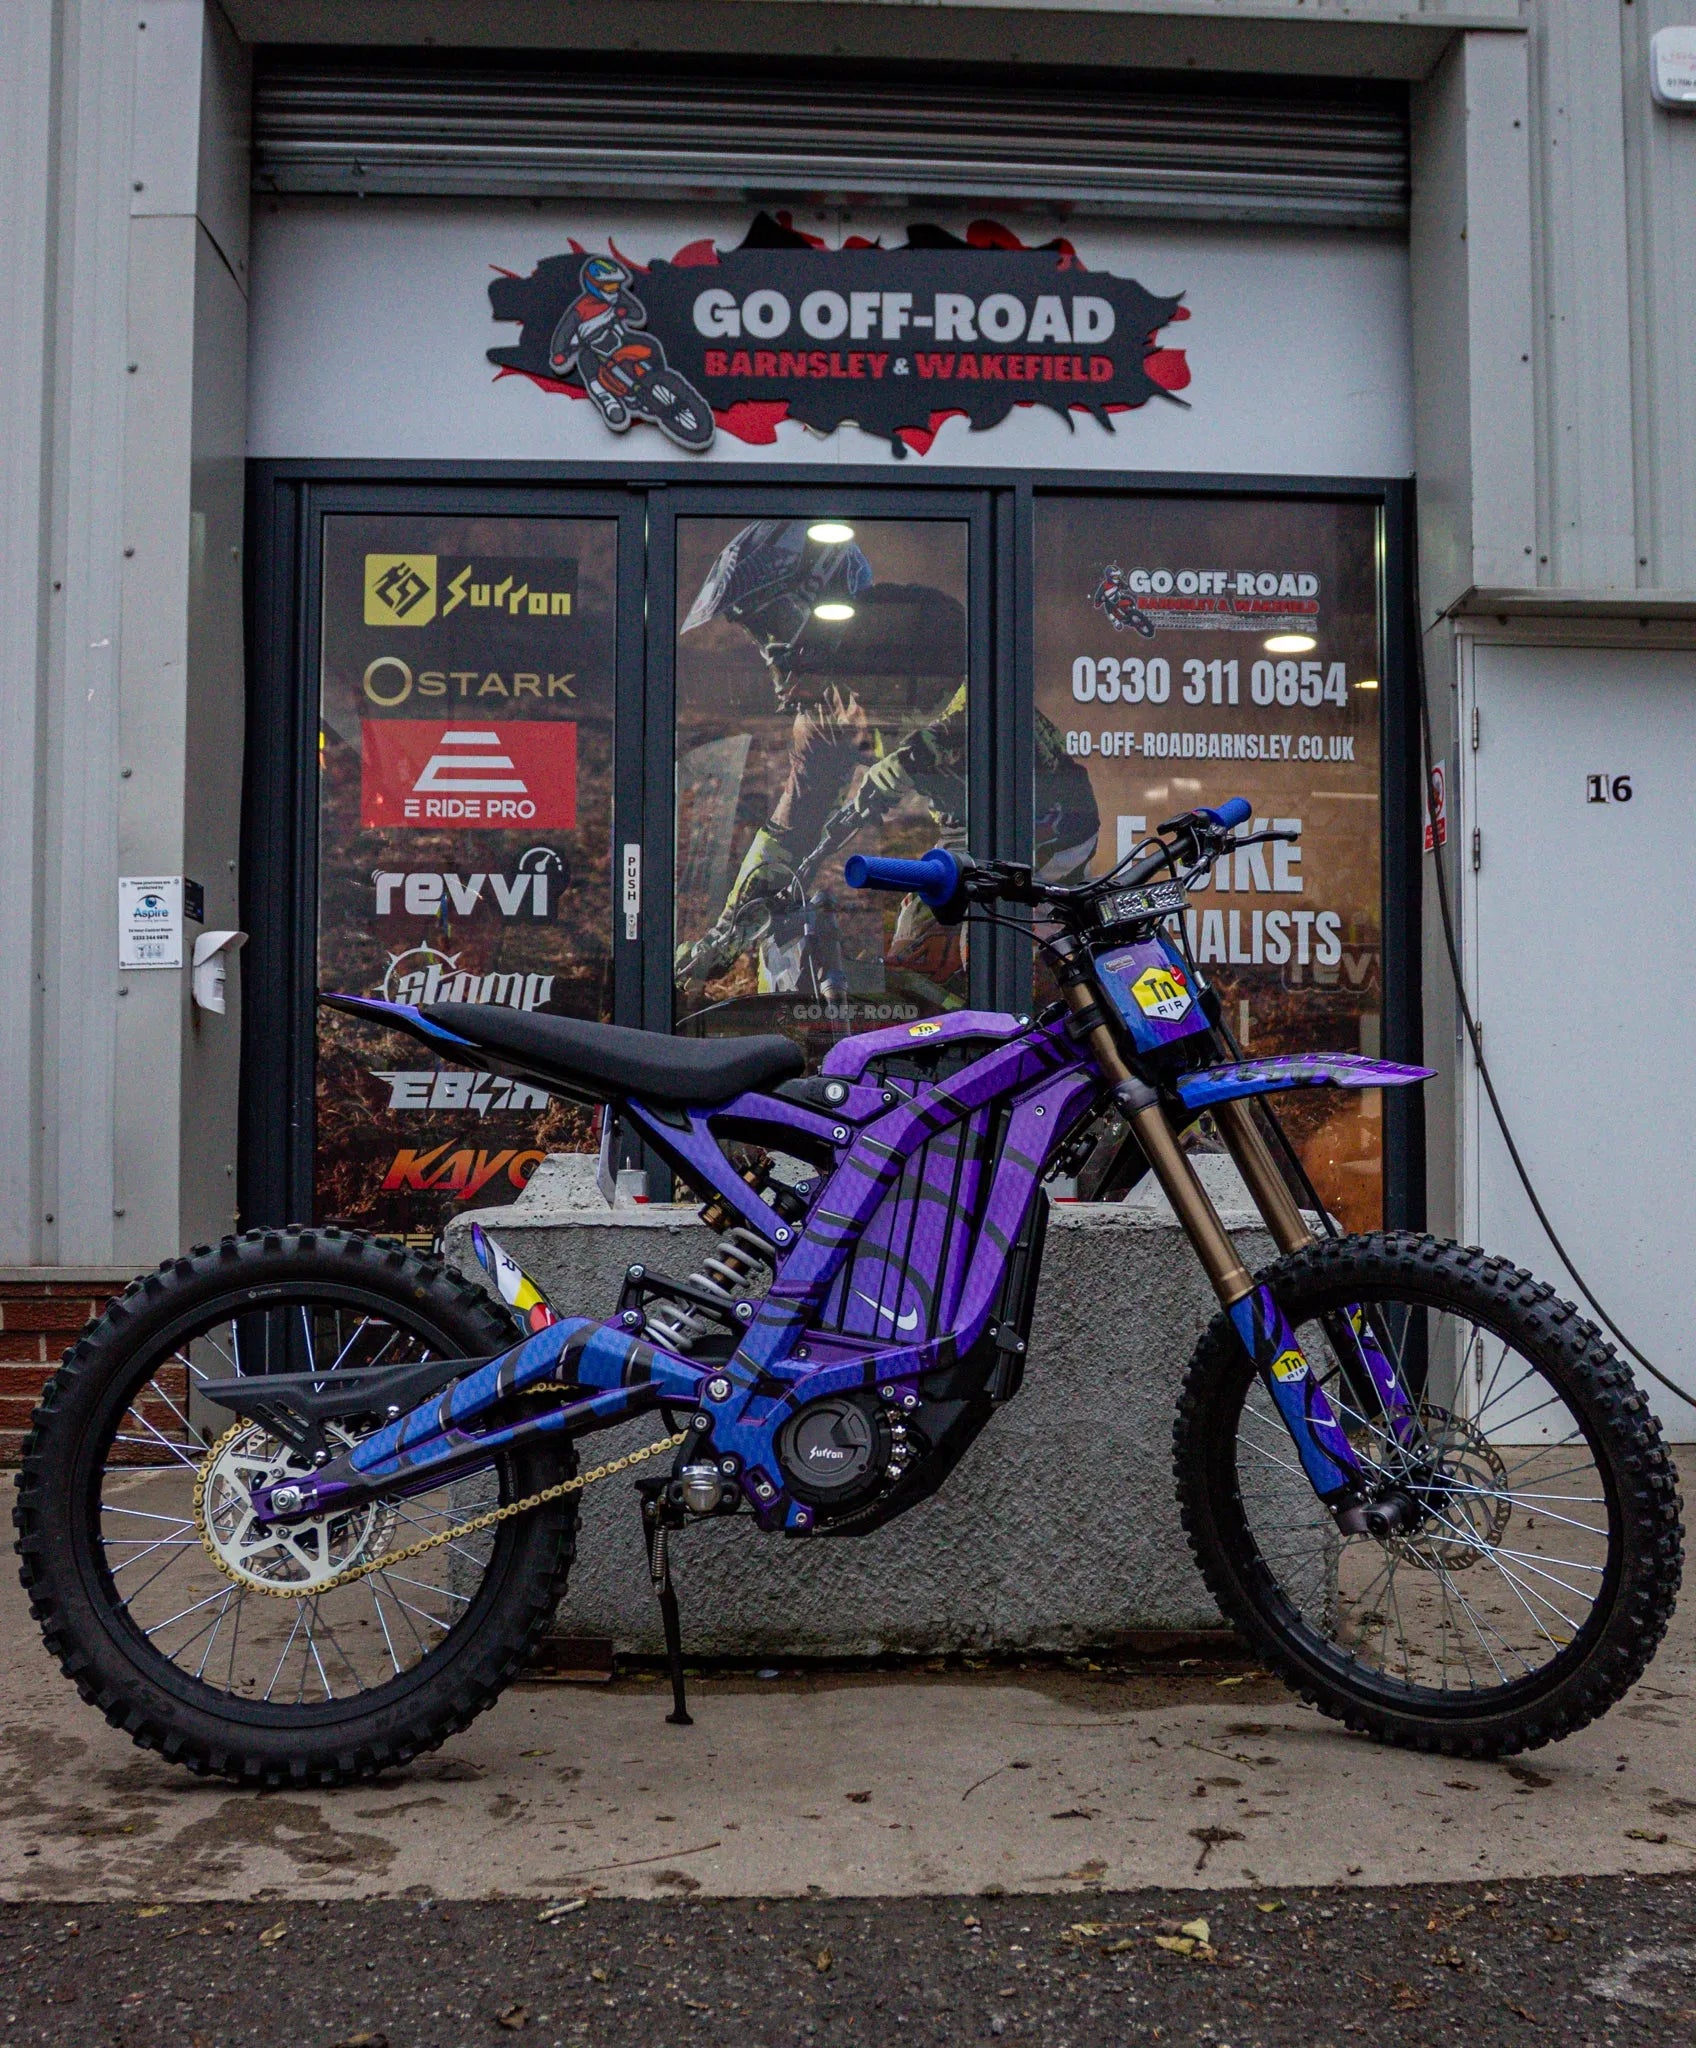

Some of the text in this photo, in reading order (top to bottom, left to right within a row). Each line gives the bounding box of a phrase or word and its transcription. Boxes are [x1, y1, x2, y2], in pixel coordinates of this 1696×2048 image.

[693, 289, 1117, 345] GO OFF-ROAD
[704, 349, 1115, 383] BARNSLEY & WAKEFIELD
[442, 564, 572, 617] Surron
[1128, 569, 1320, 598] GO OFF-ROAD
[416, 670, 577, 698] STARK
[1071, 655, 1349, 708] 0330 311 0854
[1065, 729, 1355, 762] GO-OFF-ROADBARNSLEY.CO.UK
[1589, 774, 1633, 803] 16
[403, 798, 536, 820] E RIDE PRO
[371, 850, 556, 917] revvi
[627, 856, 637, 901] PUSH
[133, 907, 169, 919] Aspire
[1143, 977, 1178, 1003] Tn
[793, 1004, 918, 1020] GO OFF-ROAD
[1157, 1000, 1184, 1015] AIR
[1280, 1358, 1302, 1372] Tn
[809, 1446, 843, 1459] Surron
